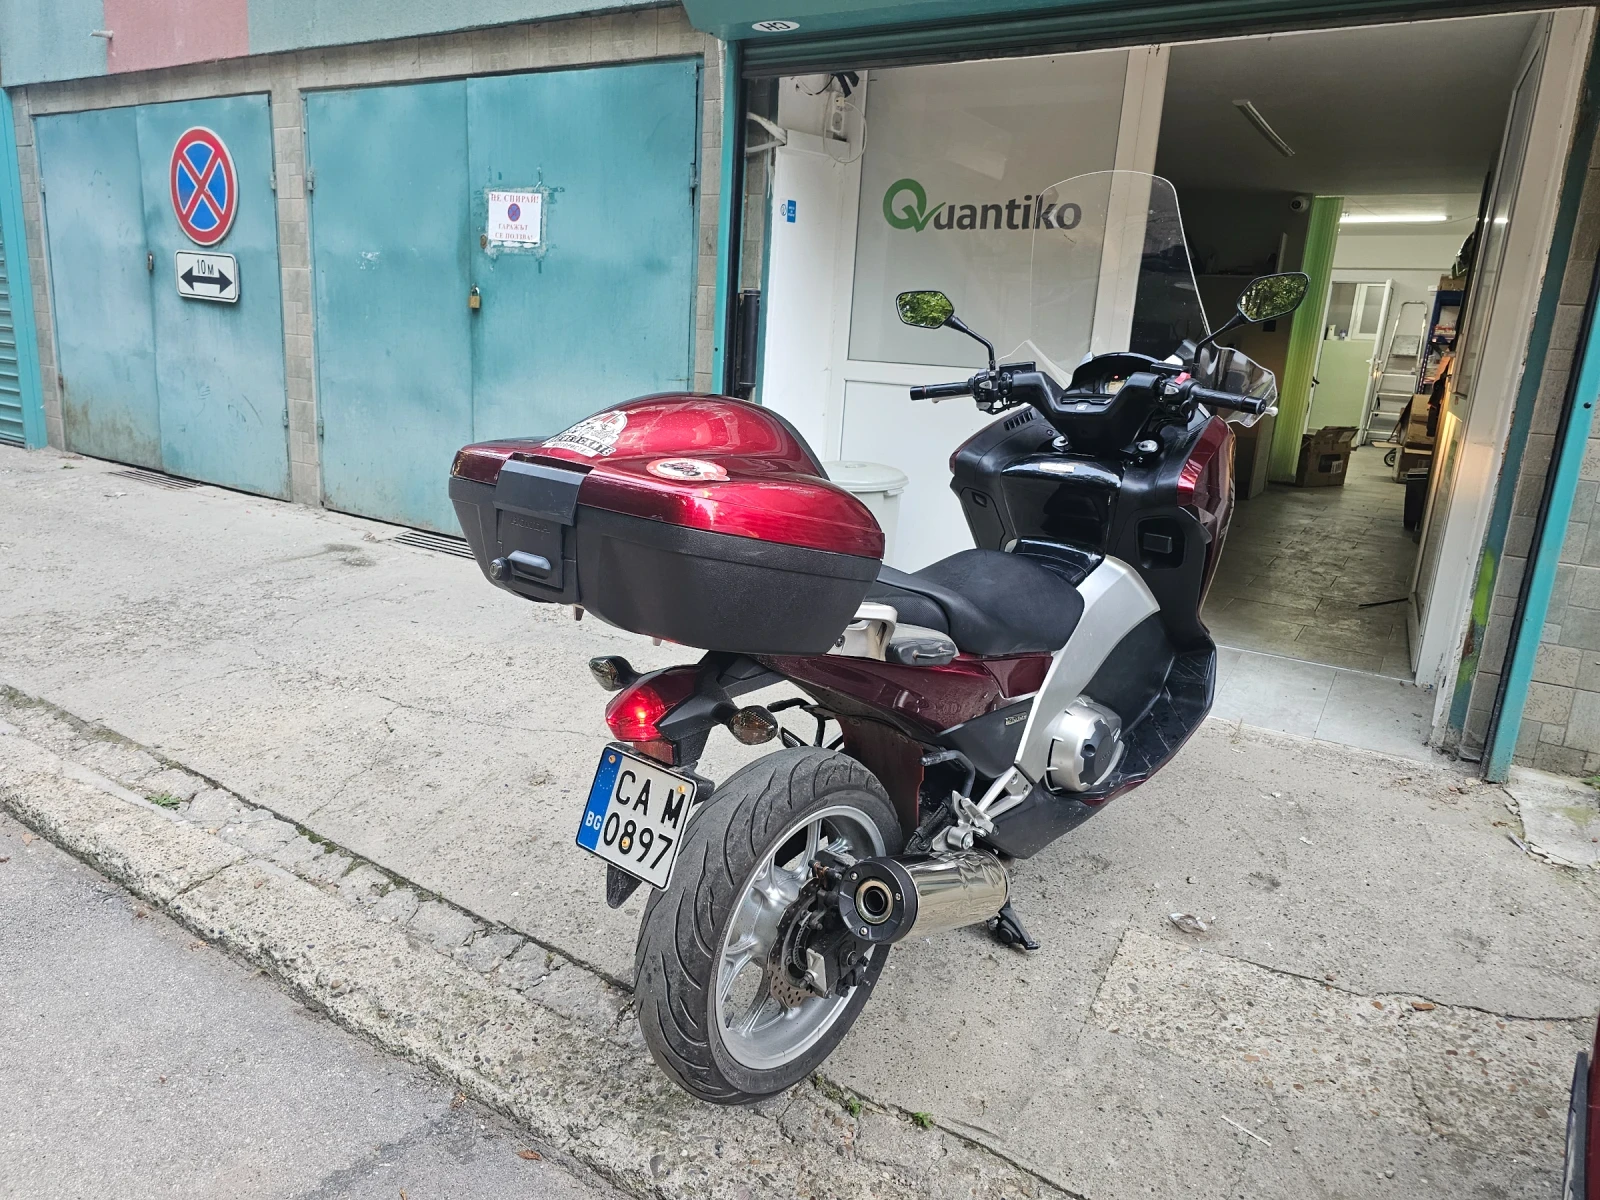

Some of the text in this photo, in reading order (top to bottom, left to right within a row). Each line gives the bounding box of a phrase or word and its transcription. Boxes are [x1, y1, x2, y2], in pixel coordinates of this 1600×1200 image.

[491, 193, 539, 204] НЕ СПИРАЙ!
[883, 178, 1082, 233] Quantiko
[498, 223, 528, 231] ГАРАЖЪТ
[616, 770, 686, 829] CA M
[585, 811, 602, 831] BG
[603, 812, 674, 870] 0897
